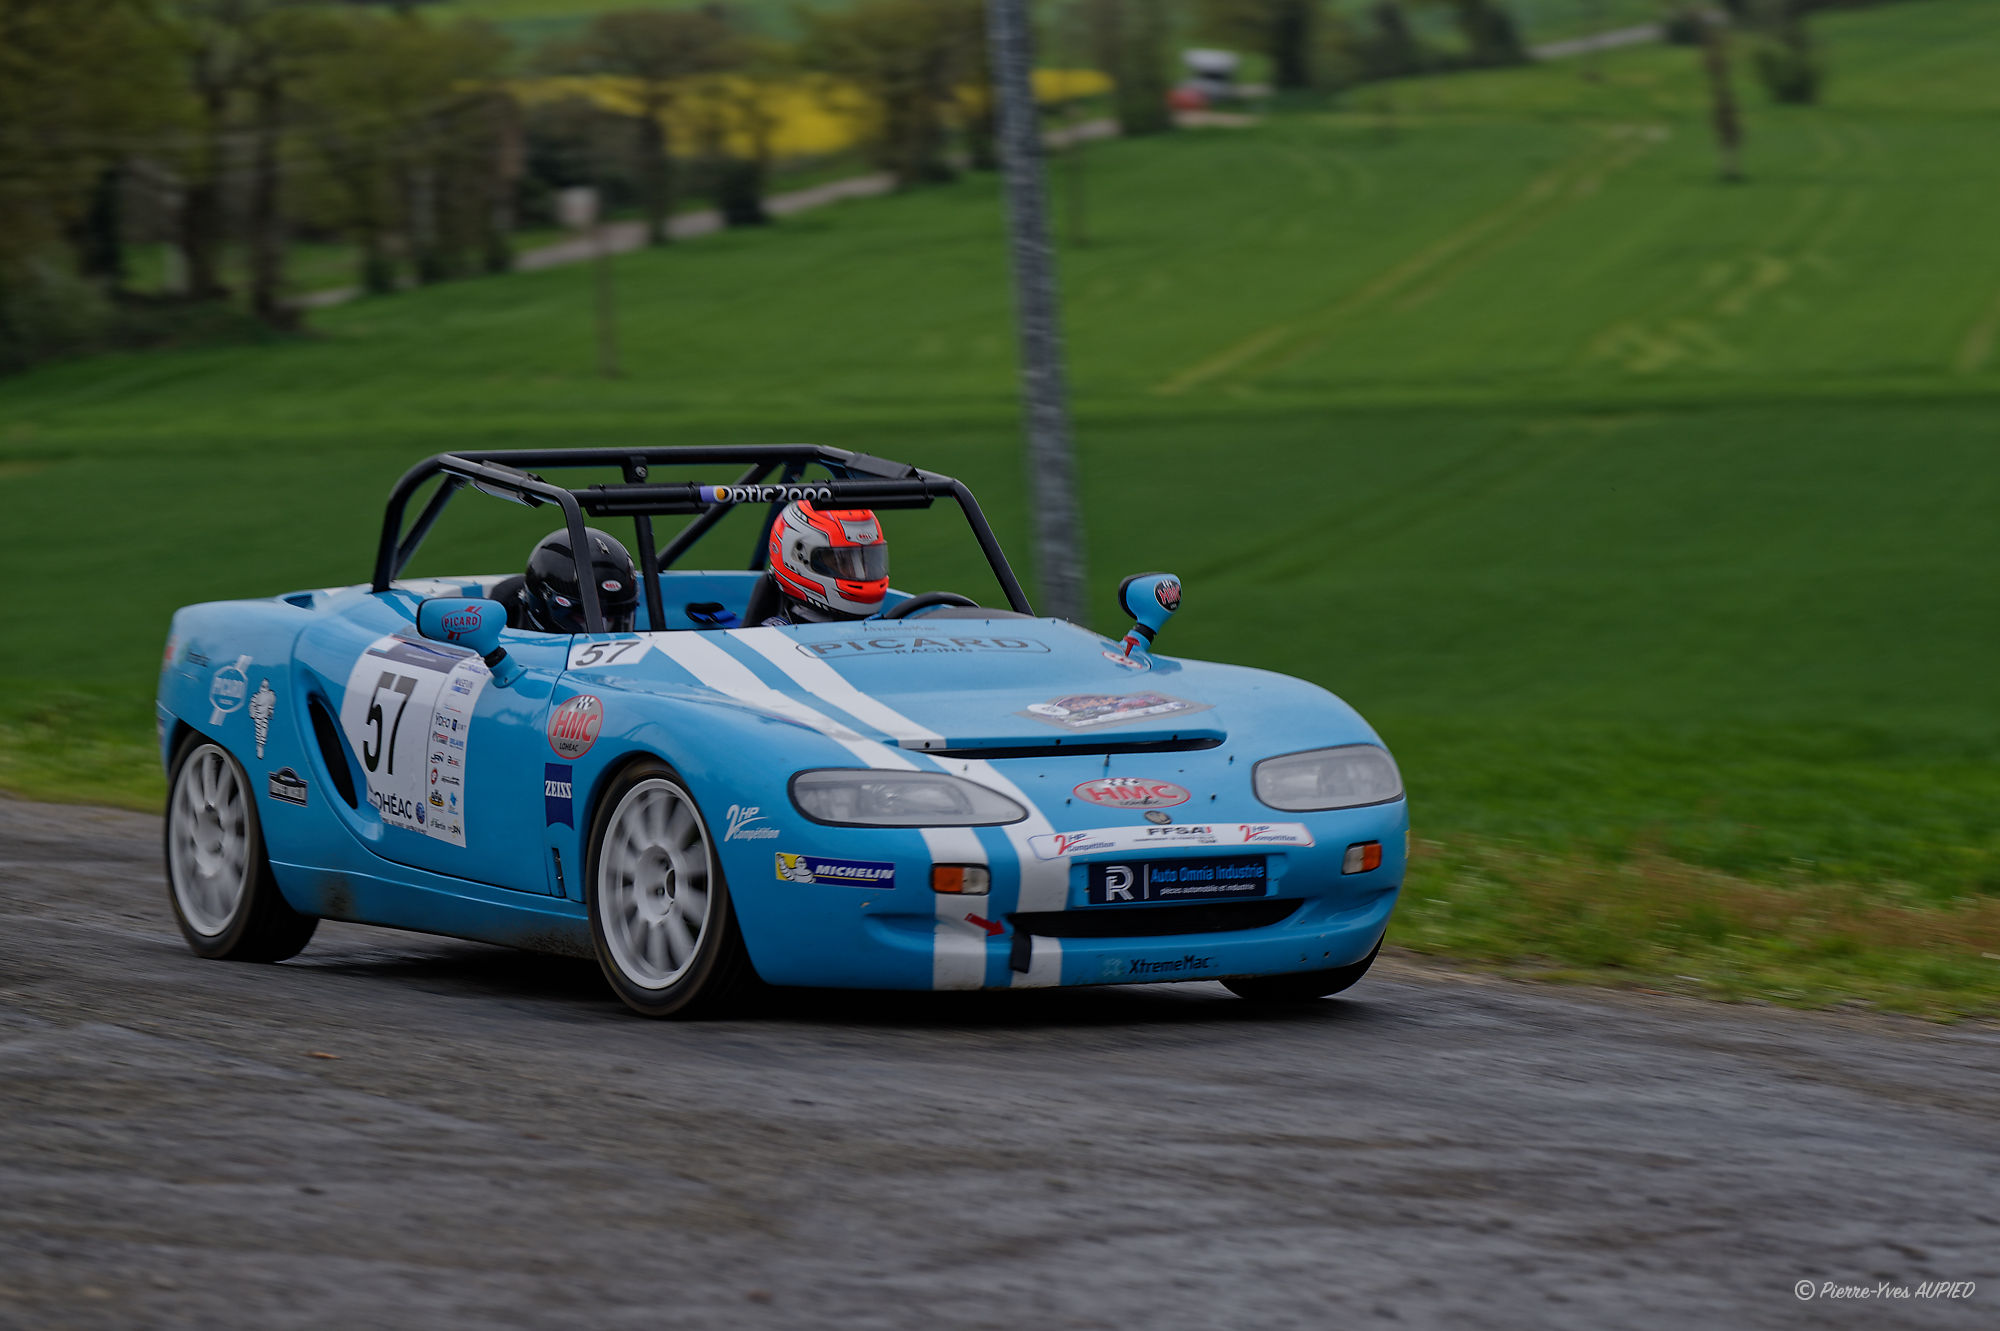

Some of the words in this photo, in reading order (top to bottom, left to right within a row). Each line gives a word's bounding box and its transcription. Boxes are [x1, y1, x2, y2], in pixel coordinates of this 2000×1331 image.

[444, 616, 478, 628] PICARD
[569, 640, 640, 667] 57
[809, 637, 1029, 655] PICARD
[362, 670, 419, 777] 57
[552, 709, 598, 742] HMC
[545, 780, 572, 799] ZEISS
[1085, 785, 1179, 801] HMC
[815, 864, 896, 880] MICHELIN
[1151, 867, 1178, 884] Auto
[1179, 865, 1214, 882] Omnia
[1215, 862, 1265, 880] Industrie
[1128, 954, 1211, 976] XtremeMac
